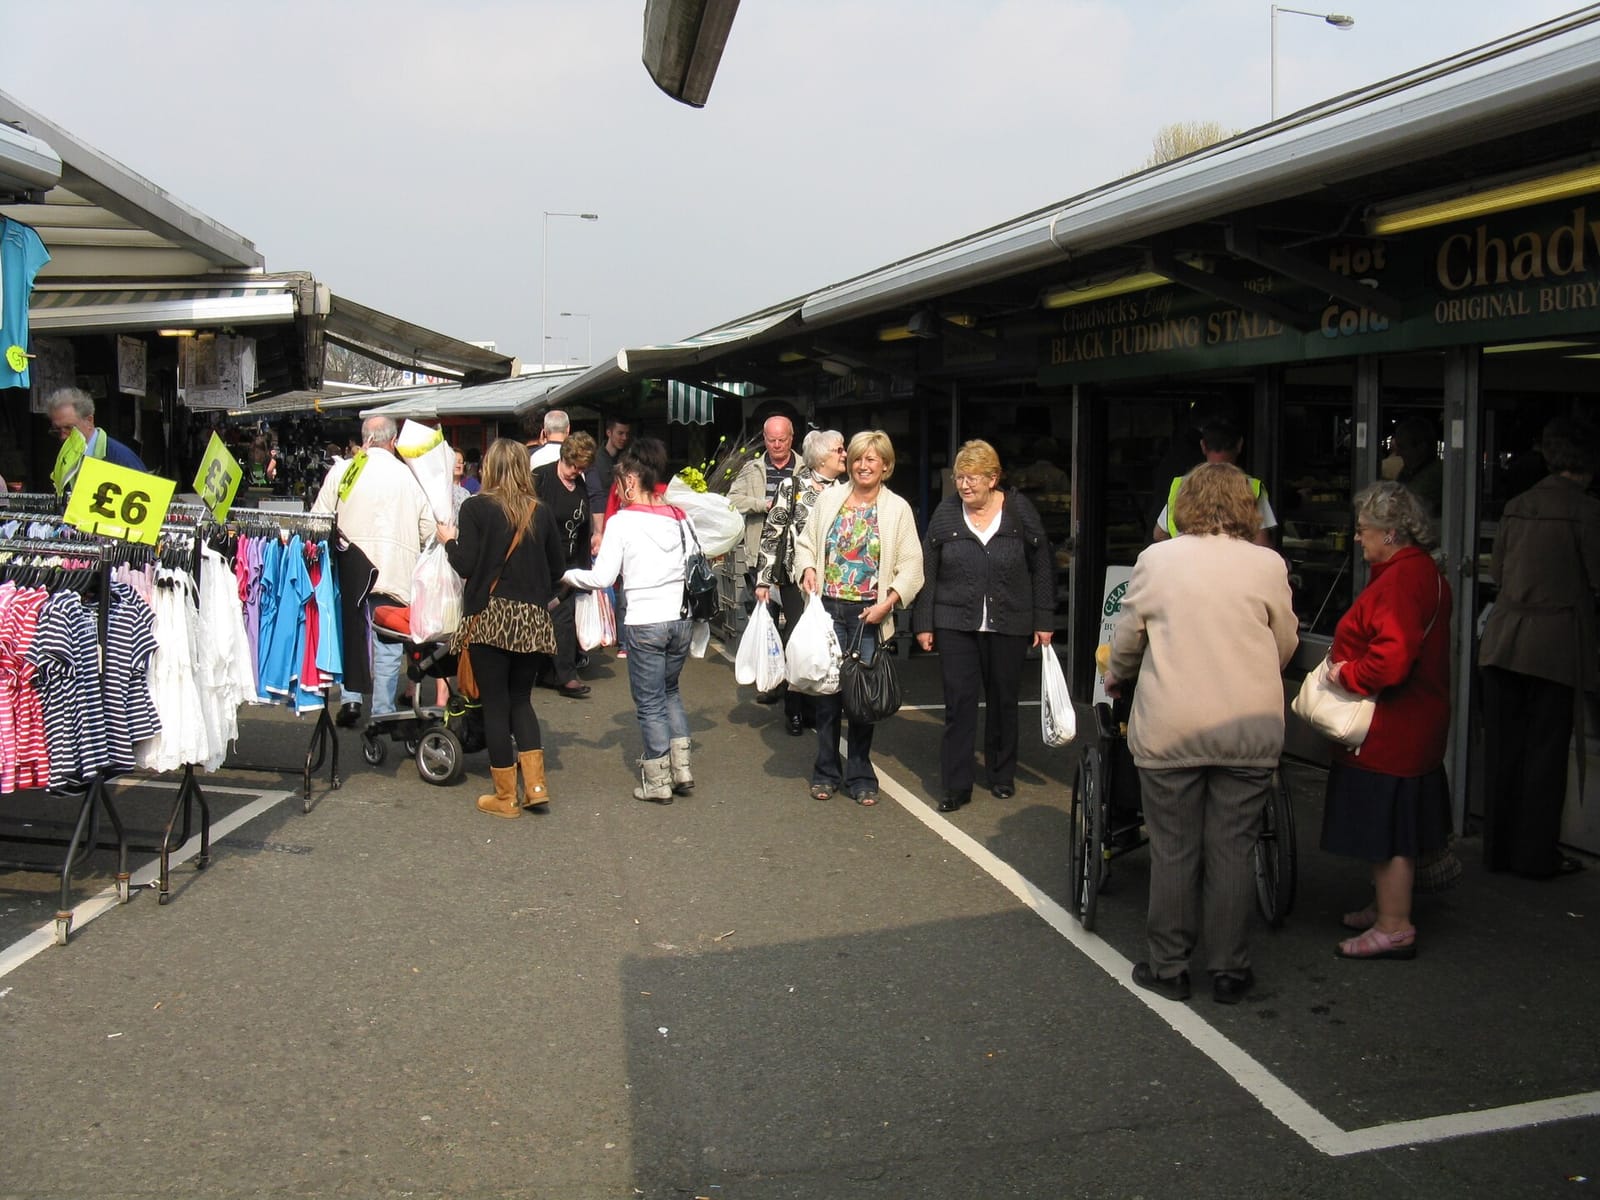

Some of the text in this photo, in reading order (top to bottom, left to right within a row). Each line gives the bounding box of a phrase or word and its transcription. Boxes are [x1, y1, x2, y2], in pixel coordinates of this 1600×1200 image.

[1328, 240, 1387, 276] Hot
[1436, 206, 1600, 291] Chad
[1435, 281, 1600, 324] ORIGINAL BURY
[1051, 331, 1105, 365] BLACK
[1111, 315, 1199, 356] PUDDING
[205, 458, 232, 503] £5
[89, 482, 151, 525] £6
